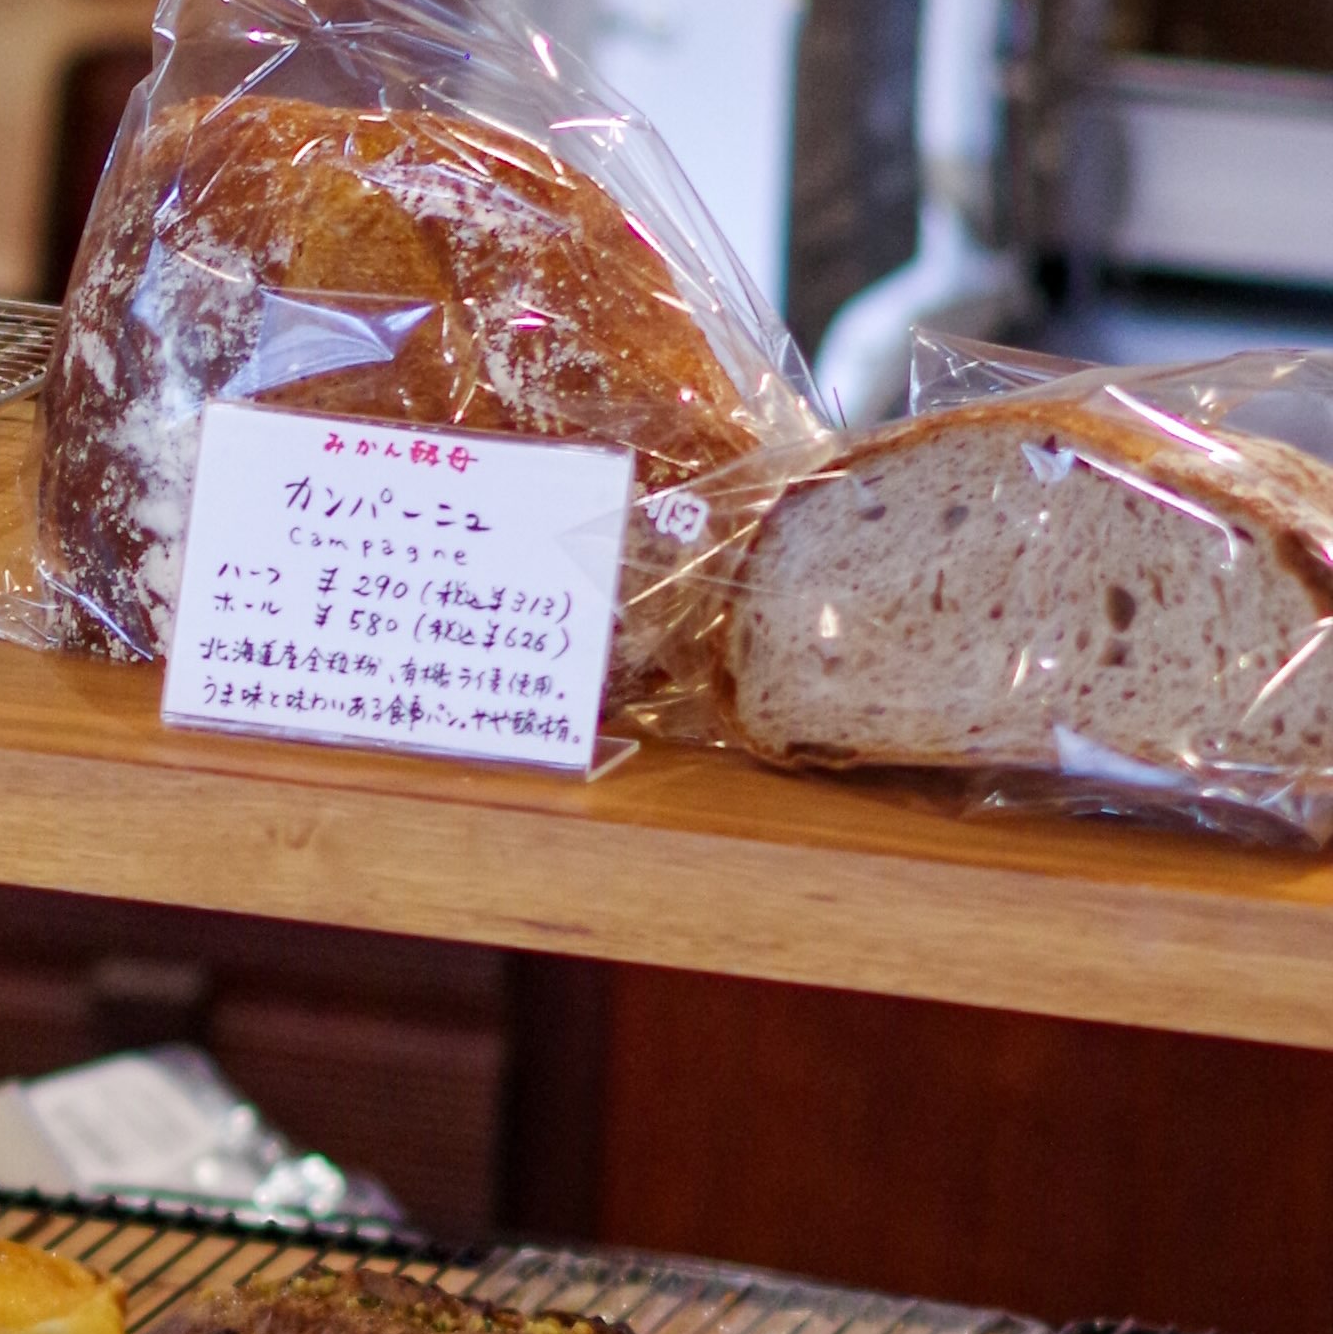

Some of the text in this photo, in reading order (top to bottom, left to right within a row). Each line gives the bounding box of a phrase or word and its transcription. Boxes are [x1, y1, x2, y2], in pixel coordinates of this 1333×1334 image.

[323, 432, 478, 473] みかん酵母
[285, 475, 492, 532] カンパーニュ
[289, 526, 470, 565] Campagne
[217, 562, 282, 585] ハーフ
[214, 593, 282, 616] ホール
